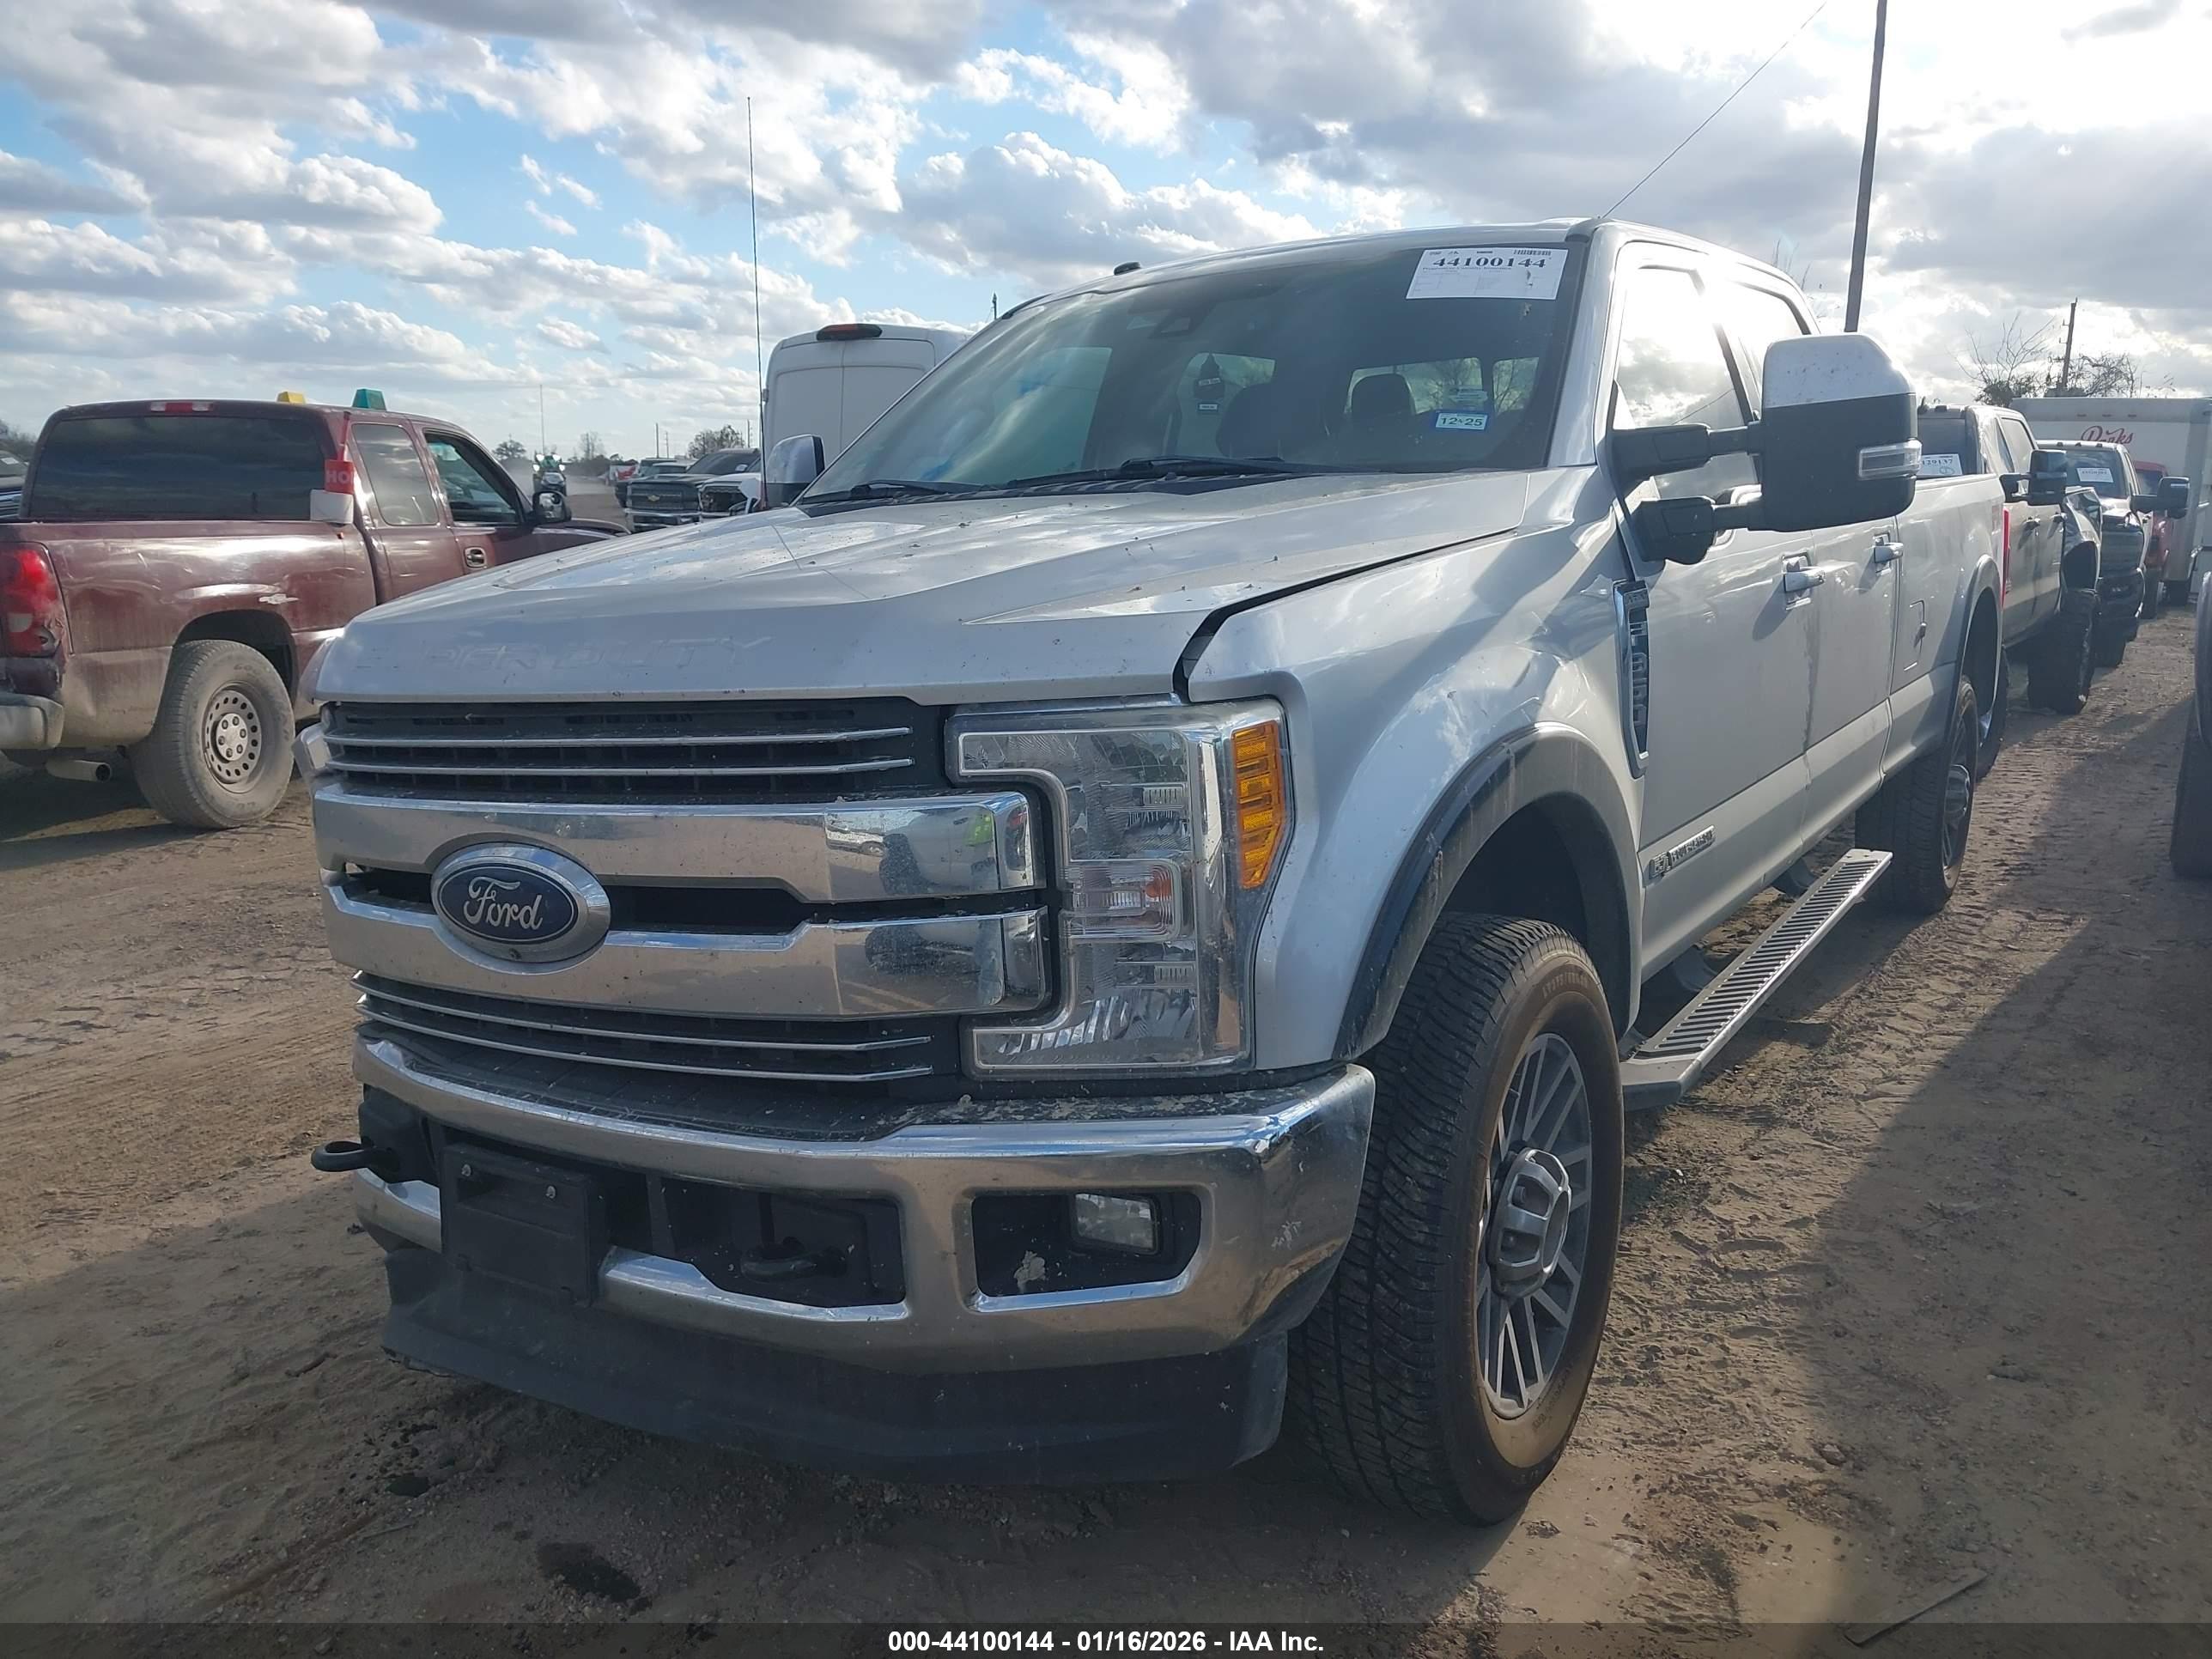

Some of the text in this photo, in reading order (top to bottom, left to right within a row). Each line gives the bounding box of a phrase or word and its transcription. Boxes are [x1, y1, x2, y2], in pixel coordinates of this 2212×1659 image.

[1432, 257, 1547, 268] 44100144
[1464, 417, 1484, 427] 25
[326, 470, 354, 485] HO
[463, 876, 544, 930] Ford
